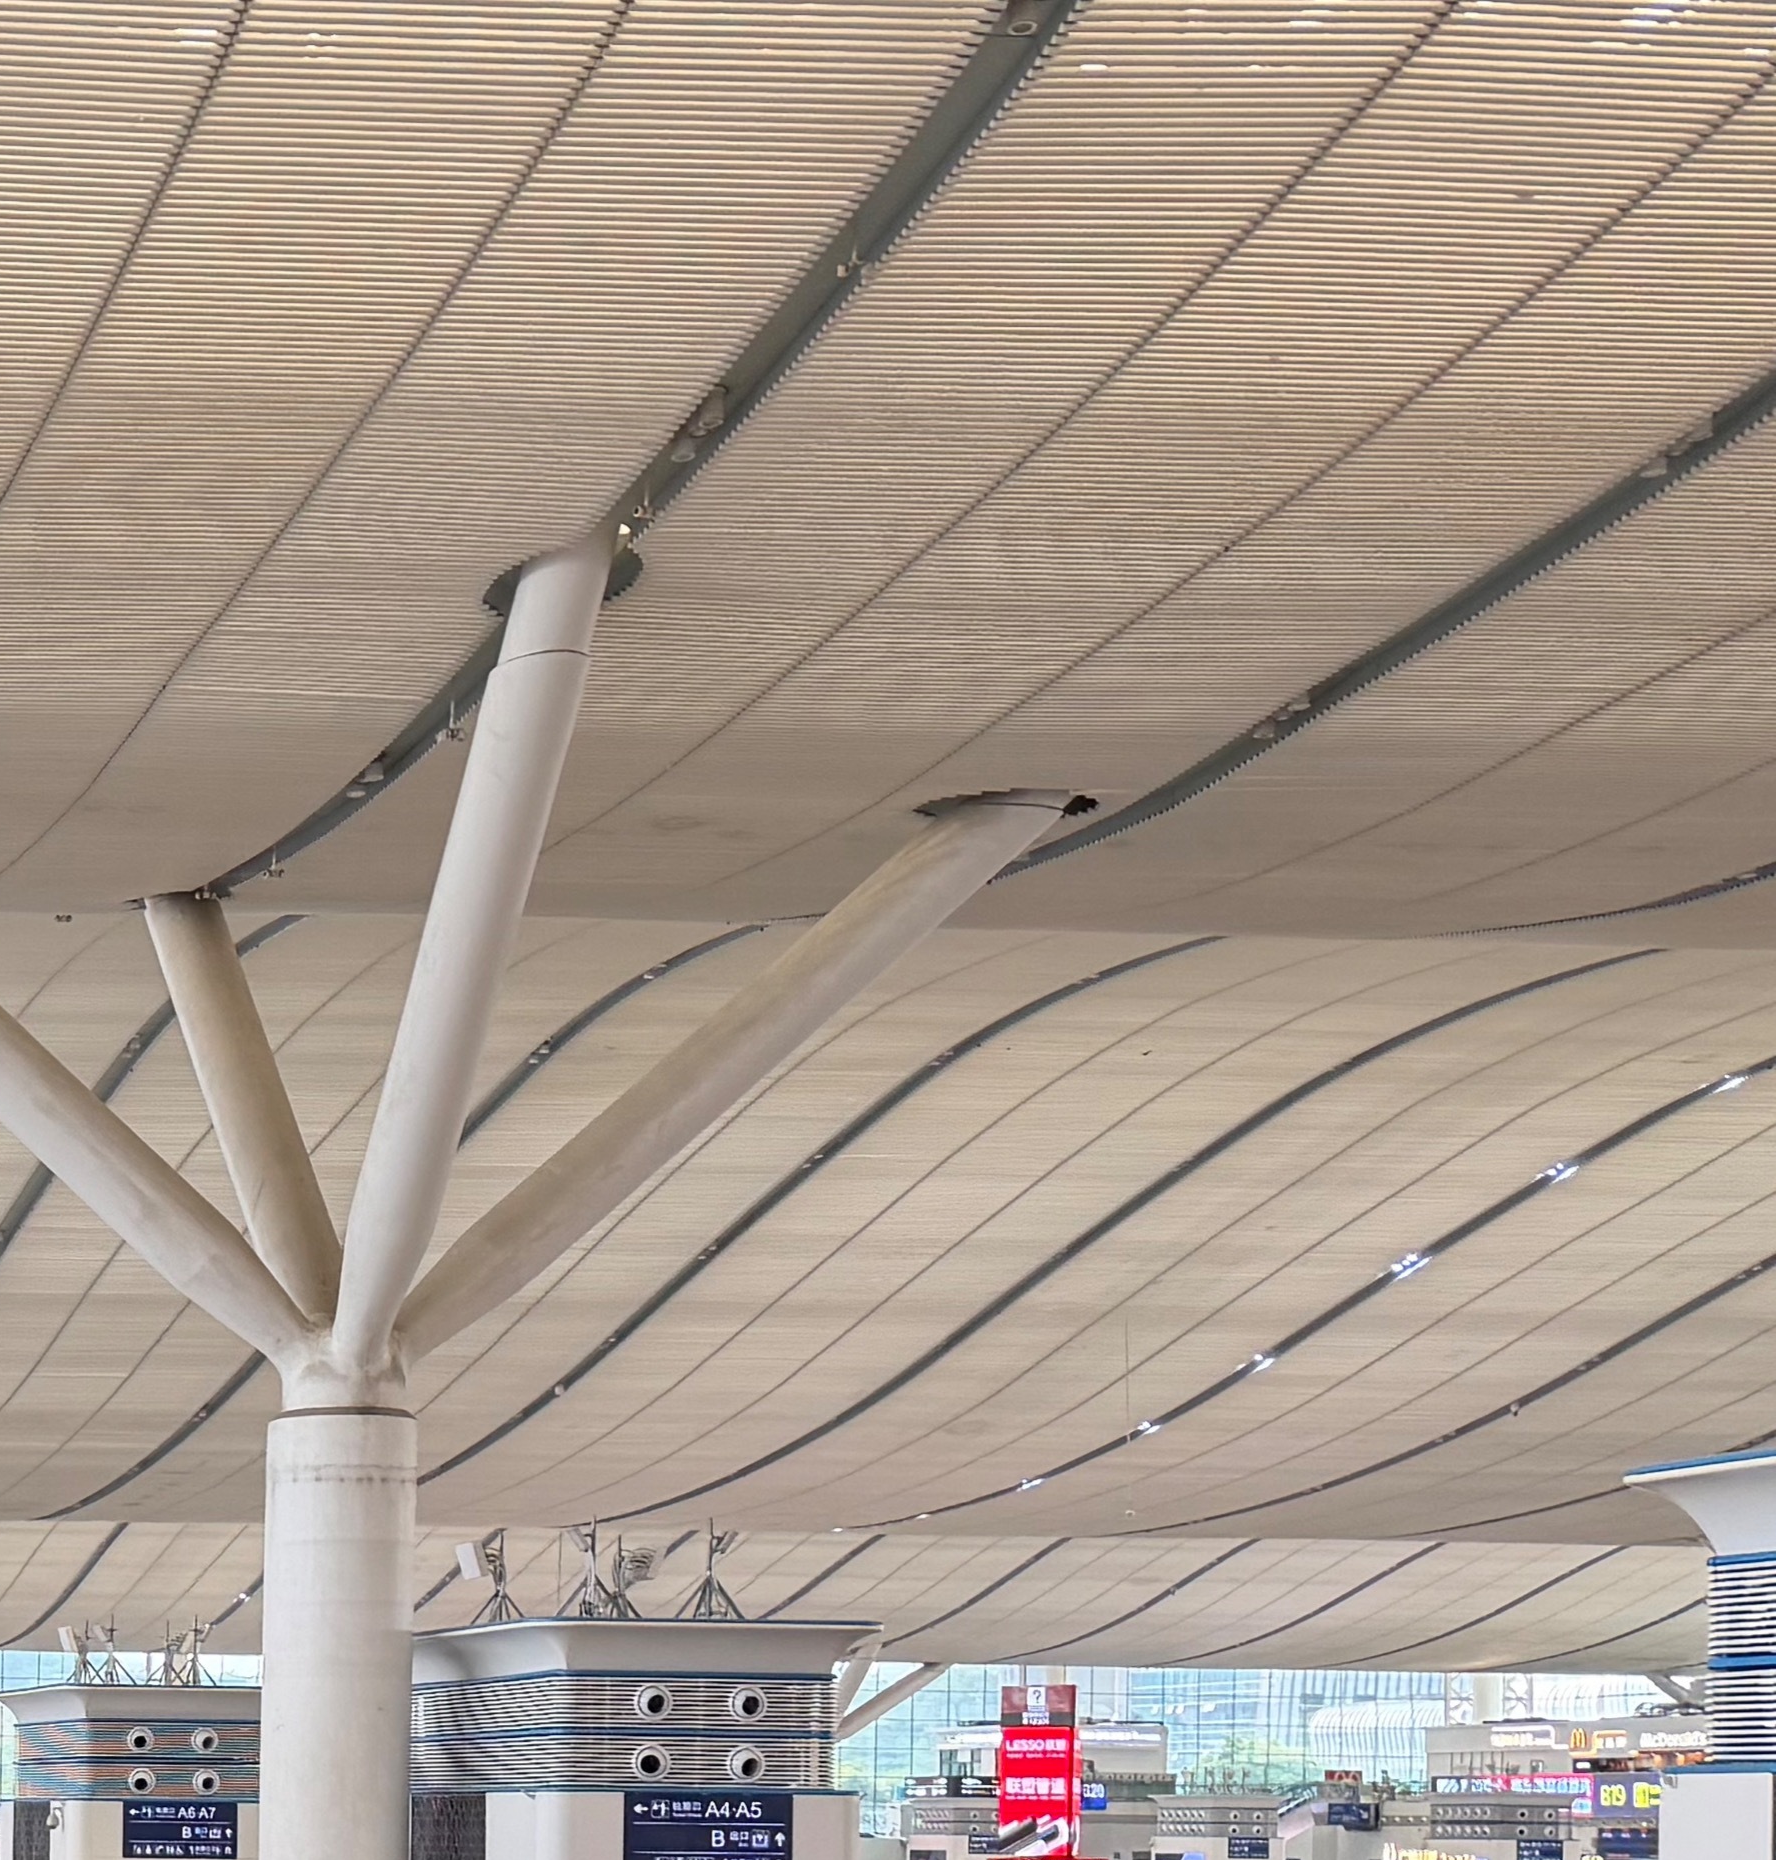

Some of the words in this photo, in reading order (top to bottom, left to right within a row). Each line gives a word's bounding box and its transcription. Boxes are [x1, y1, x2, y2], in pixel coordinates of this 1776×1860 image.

[1600, 1784, 1627, 1807] B19
[182, 1826, 192, 1839] B
[711, 1829, 726, 1848] B
